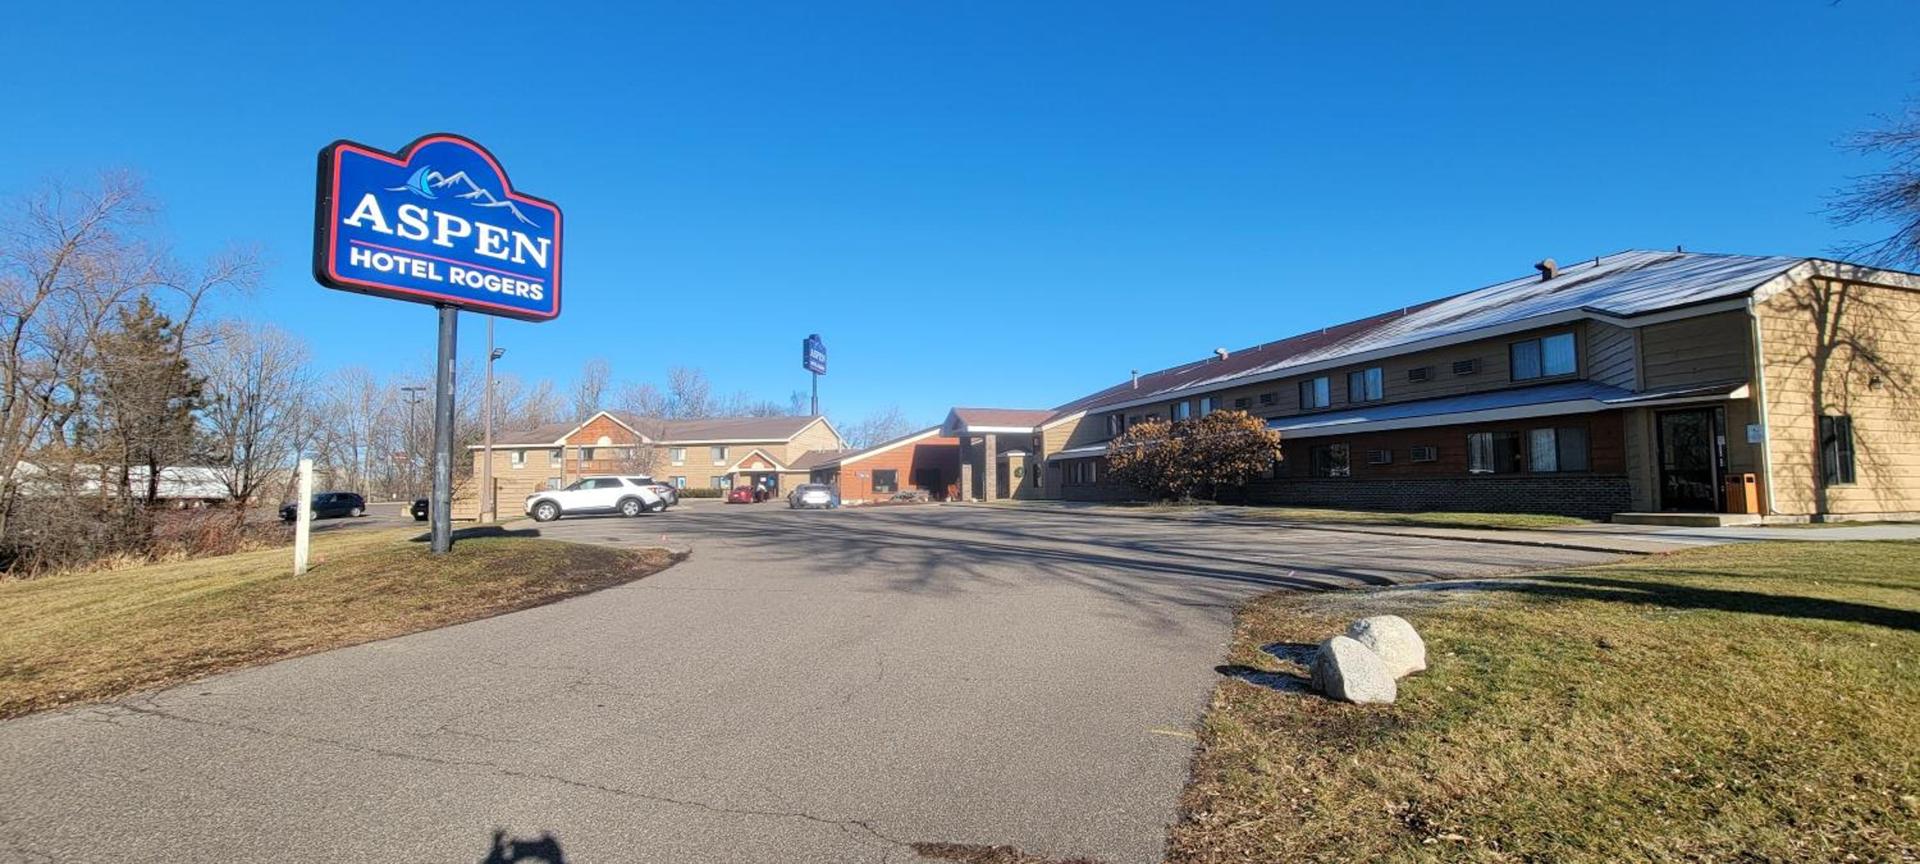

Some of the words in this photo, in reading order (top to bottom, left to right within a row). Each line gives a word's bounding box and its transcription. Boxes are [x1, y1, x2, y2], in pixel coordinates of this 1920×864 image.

[343, 193, 551, 269] ASPEN
[350, 247, 443, 282] HOTEL
[449, 266, 544, 301] ROGERS
